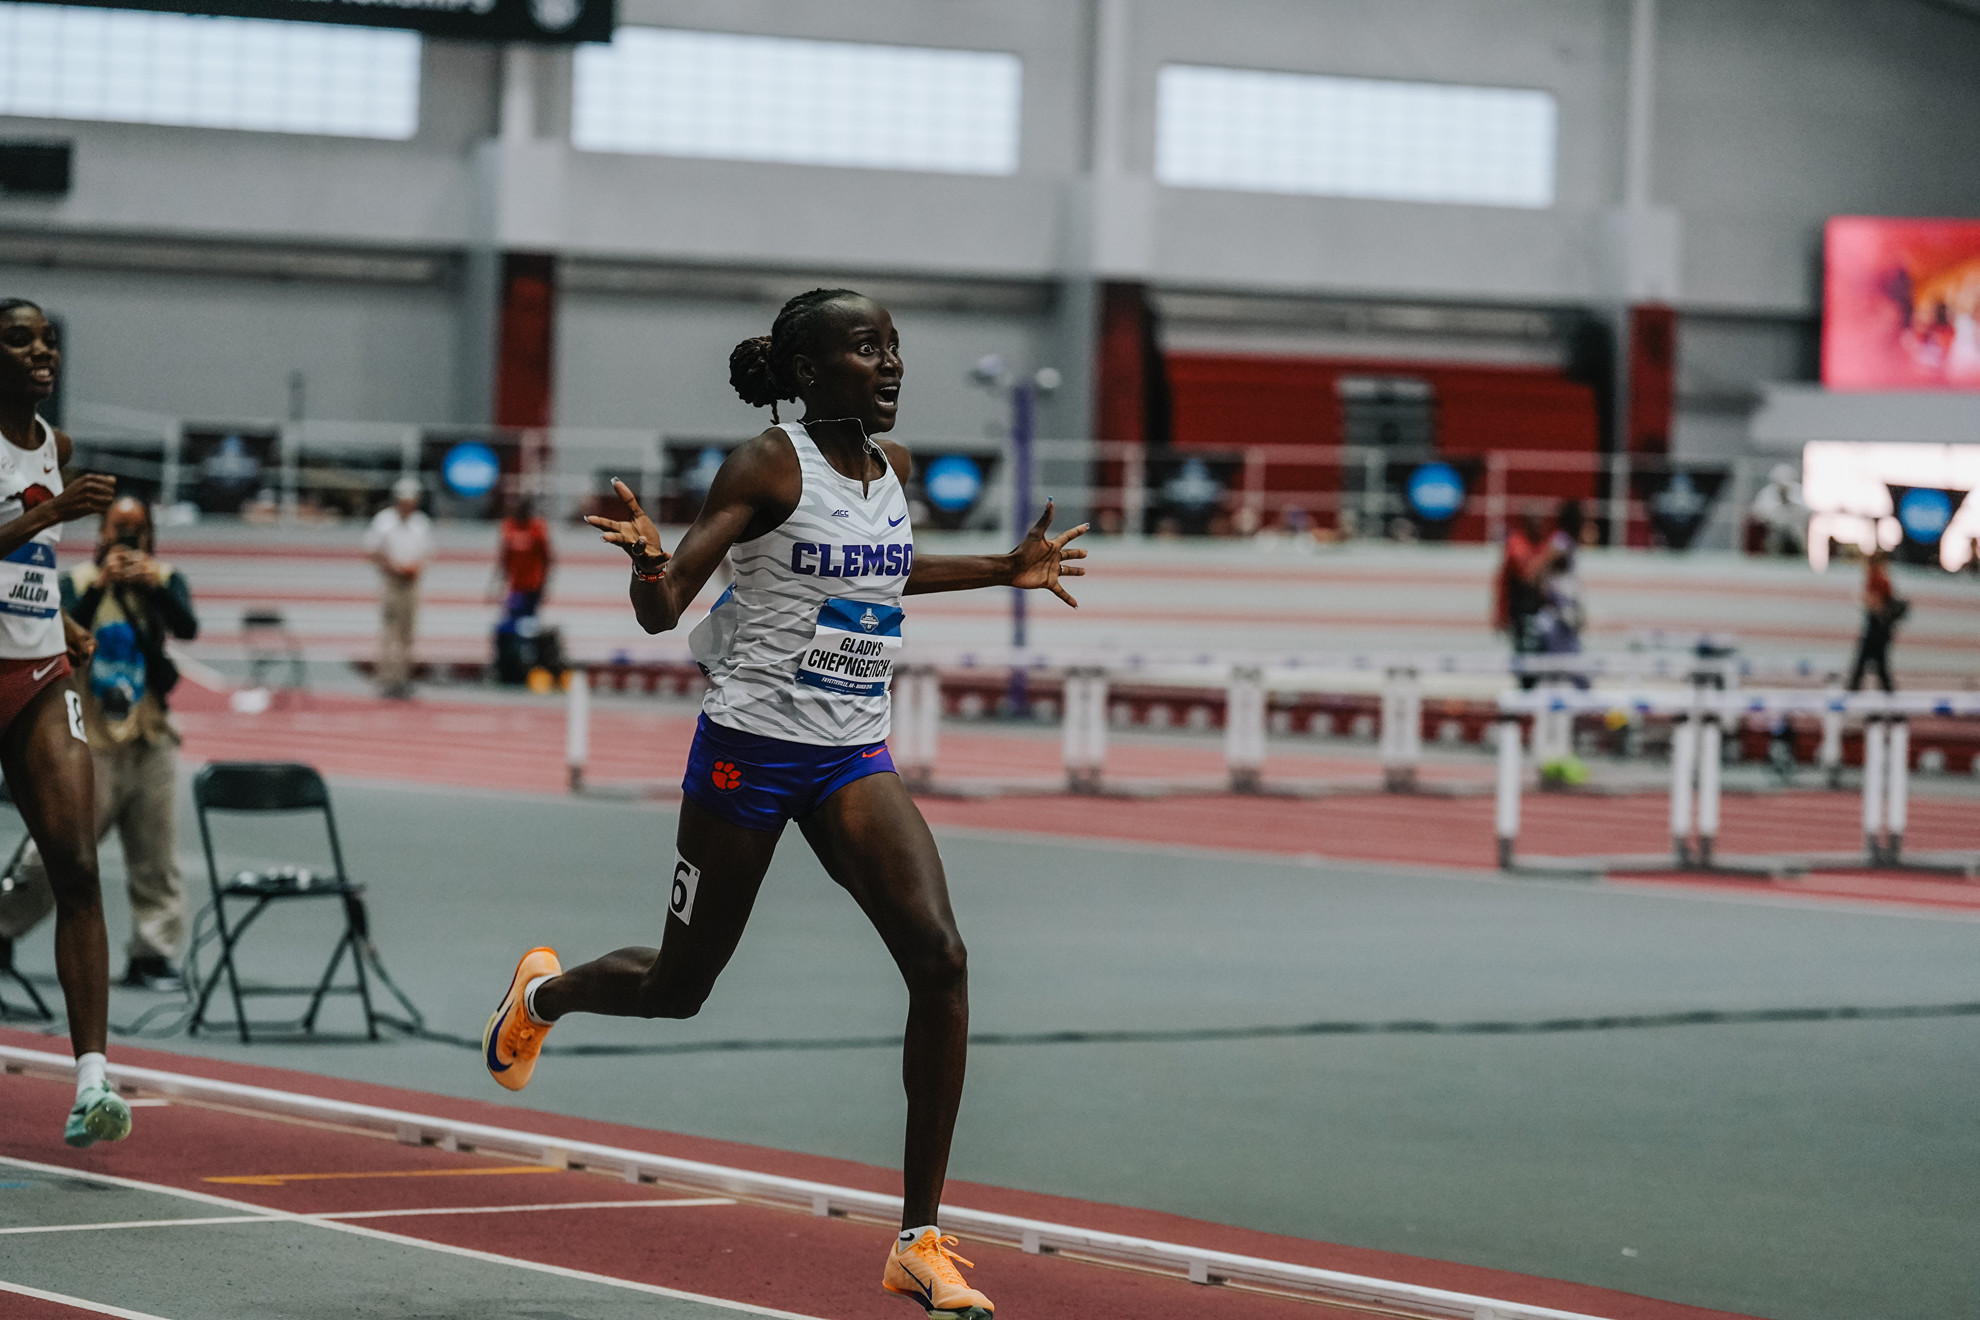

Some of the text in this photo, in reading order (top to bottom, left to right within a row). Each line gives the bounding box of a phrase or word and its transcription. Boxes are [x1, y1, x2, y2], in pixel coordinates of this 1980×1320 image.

[831, 509, 849, 518] ACC
[839, 637, 884, 657] GLADYS
[807, 649, 891, 678] CHEPNGETICH
[671, 861, 691, 913] 6
